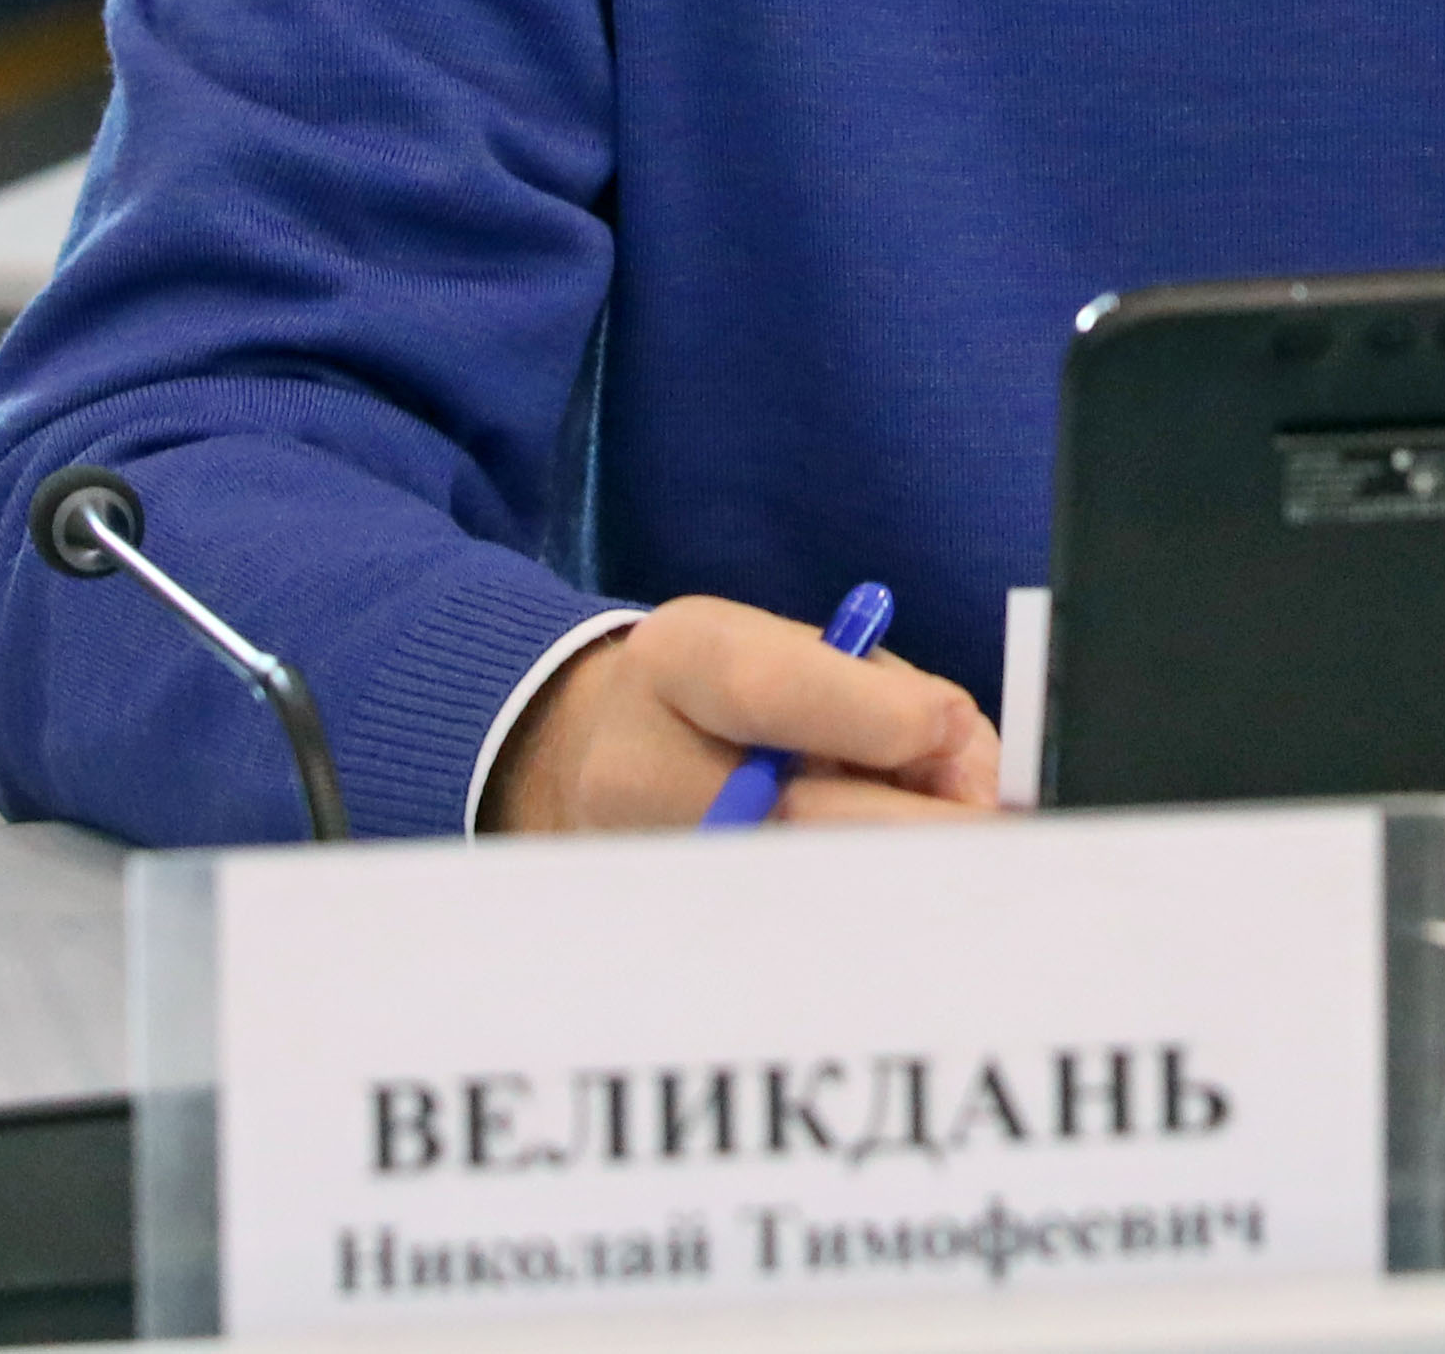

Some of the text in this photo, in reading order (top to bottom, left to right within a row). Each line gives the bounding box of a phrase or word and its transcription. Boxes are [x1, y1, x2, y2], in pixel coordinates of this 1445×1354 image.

[368, 1043, 1235, 1179] ВЕЛИКДАНЬ
[333, 1193, 1269, 1299] Николай Тимофеевич
